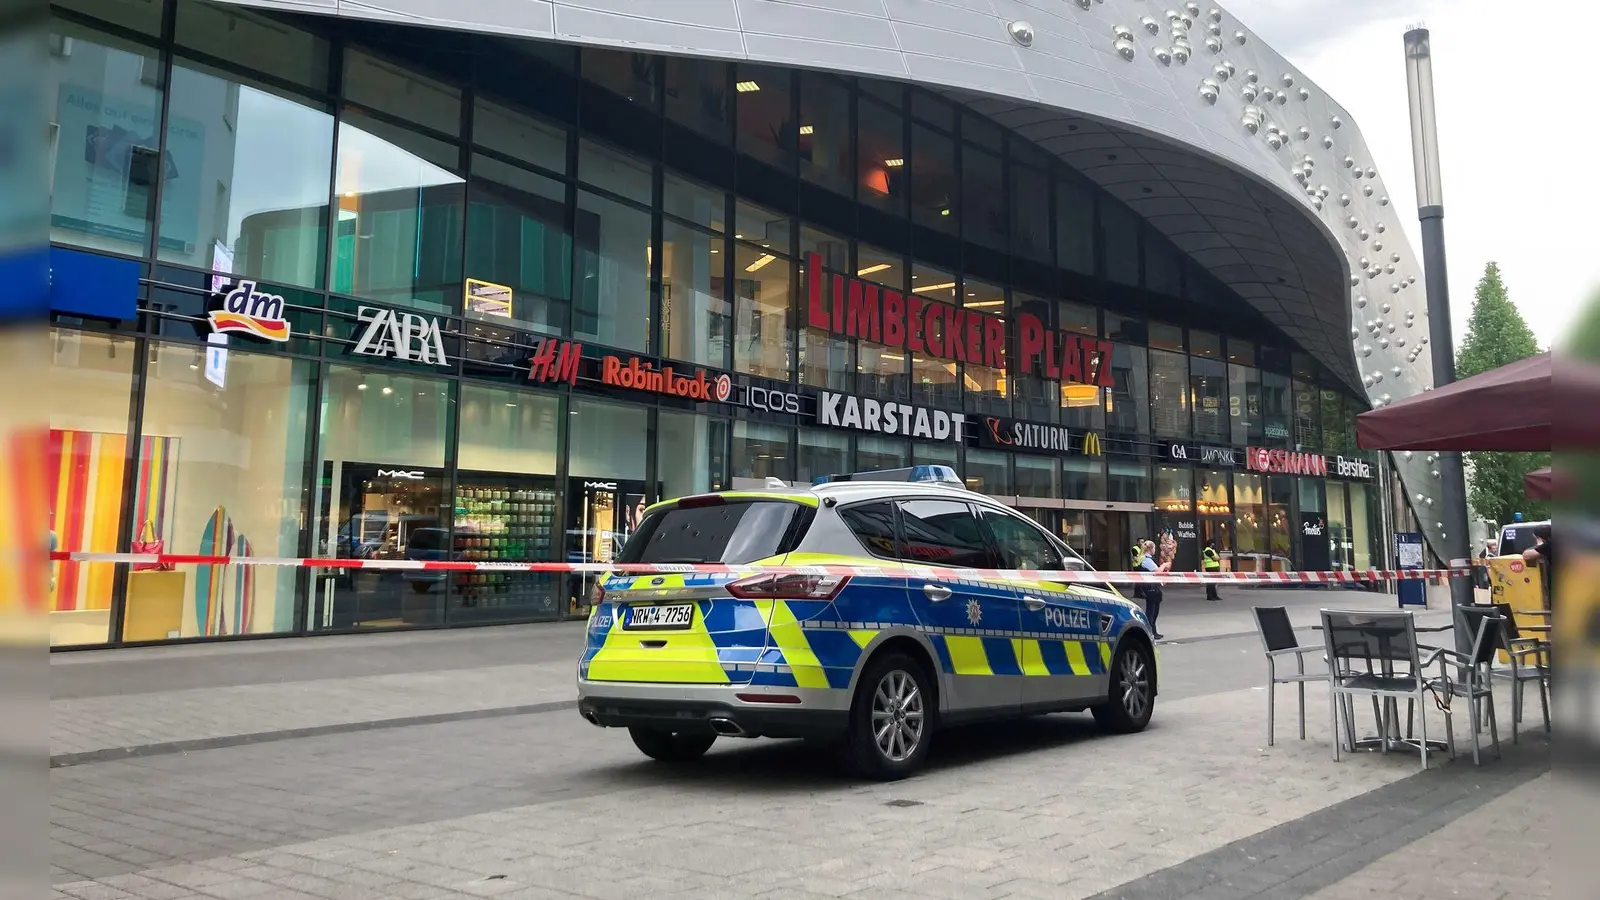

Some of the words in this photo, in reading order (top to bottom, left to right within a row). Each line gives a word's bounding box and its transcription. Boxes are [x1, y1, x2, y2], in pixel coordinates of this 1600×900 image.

[228, 284, 282, 320] dm
[808, 251, 1005, 369] LIMBECKER
[1014, 311, 1116, 387] PLATZ
[353, 305, 452, 367] ZARA
[530, 338, 583, 386] H&M
[602, 355, 663, 393] Robin
[664, 366, 712, 400] Look
[745, 385, 800, 413] IQOS
[819, 391, 966, 442] KARSTADT
[1014, 422, 1069, 450] SATURN
[377, 469, 424, 479] MAC
[1246, 446, 1327, 476] ROSSMANN
[1337, 455, 1370, 478] Bershka
[584, 481, 617, 490] MAC
[632, 608, 649, 624] NRW
[655, 606, 690, 622] 4-7756
[1044, 607, 1091, 629] POLIZEI
